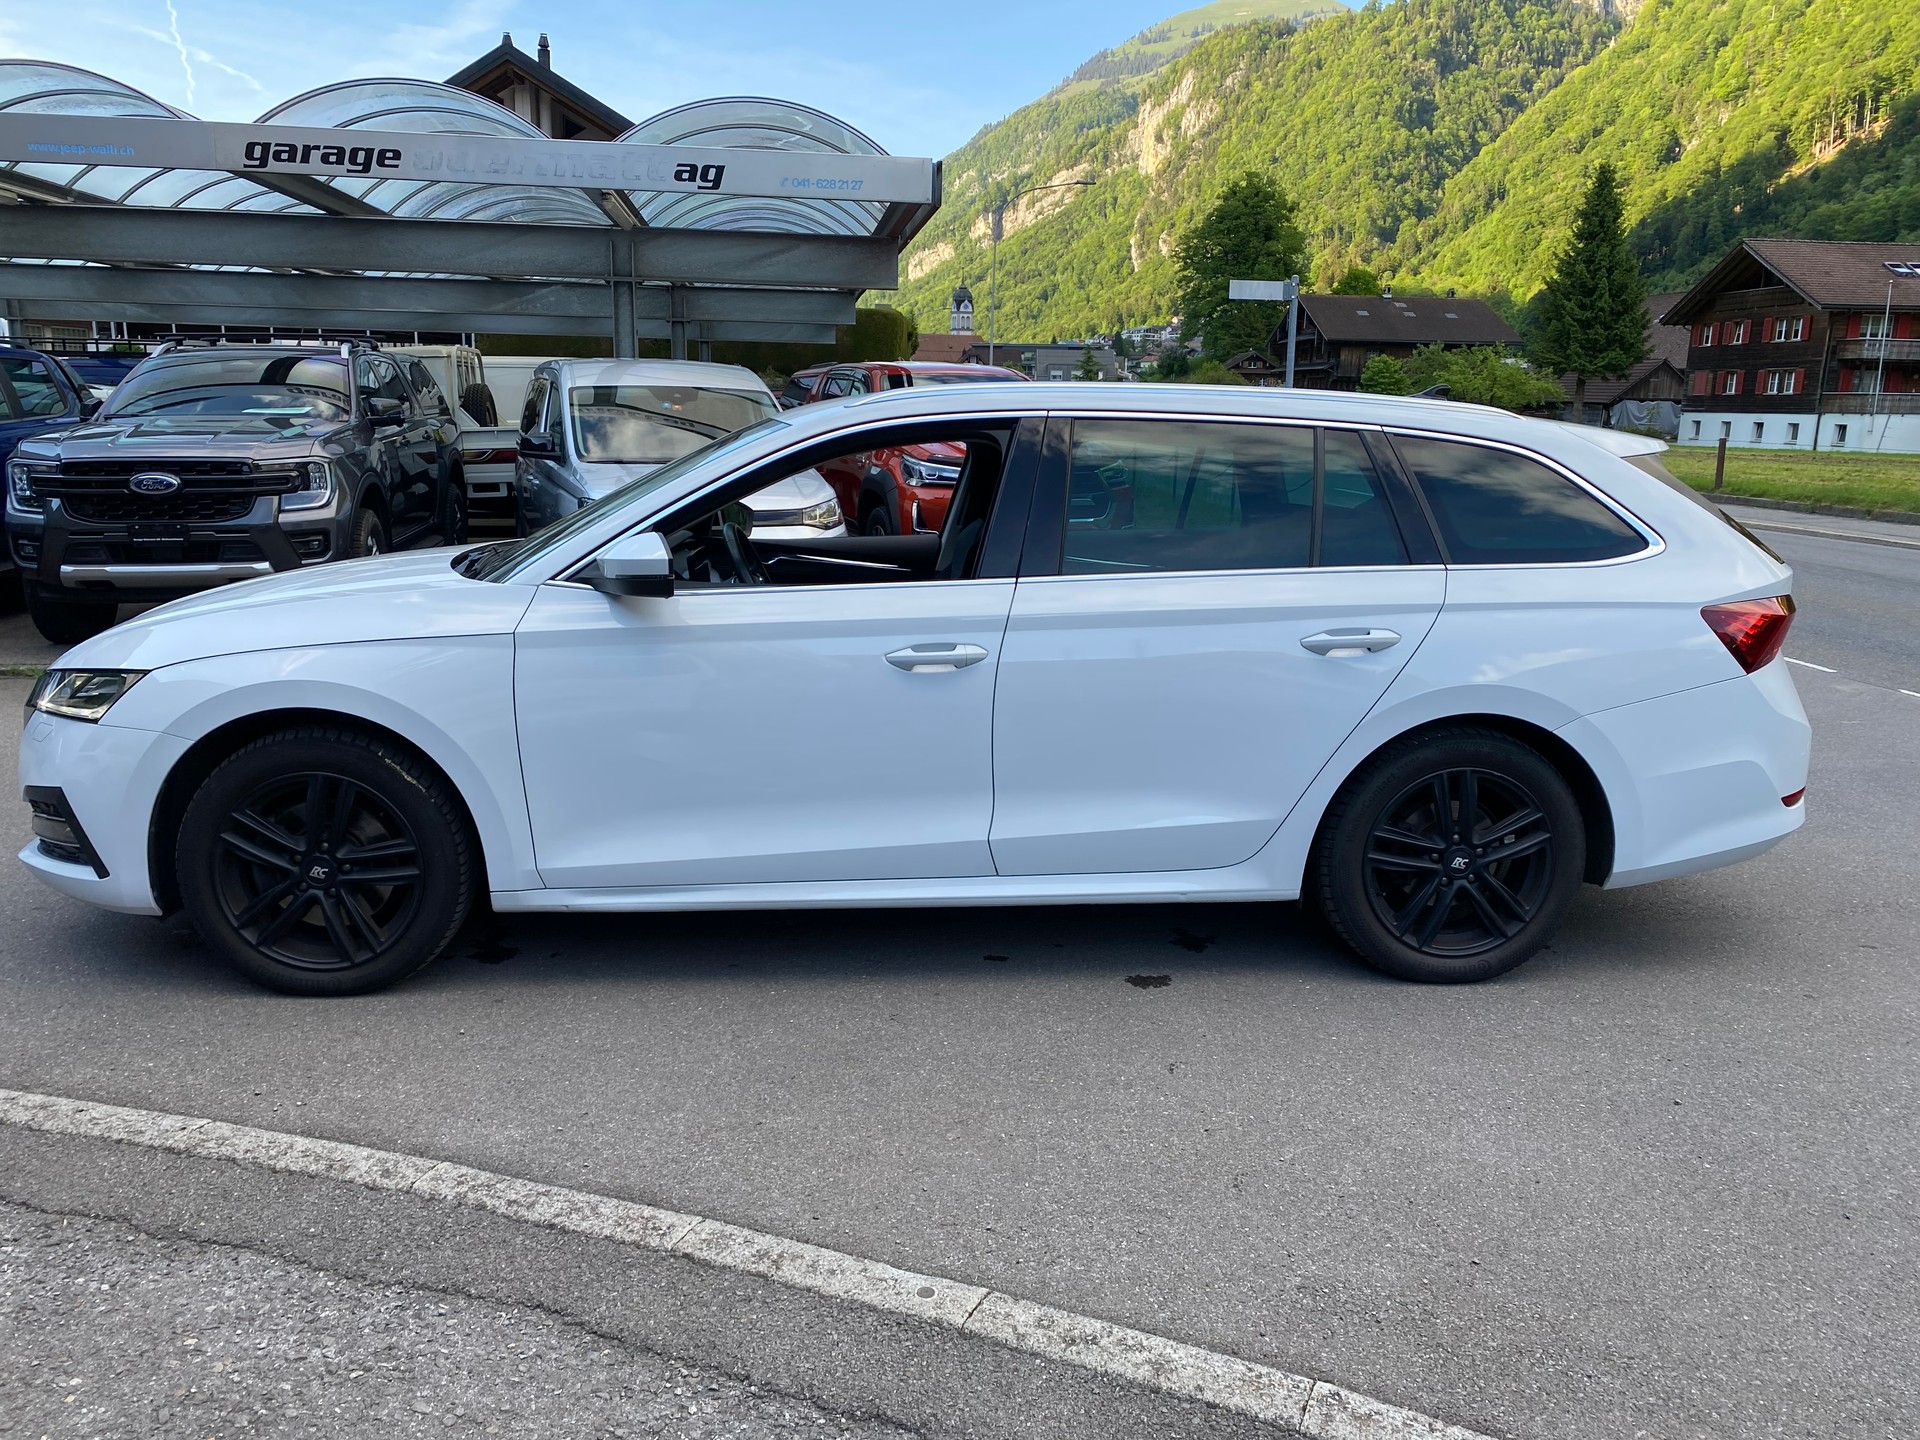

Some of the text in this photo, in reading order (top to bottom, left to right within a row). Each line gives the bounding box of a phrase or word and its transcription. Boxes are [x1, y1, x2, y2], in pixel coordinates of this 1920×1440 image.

[243, 141, 402, 174] garage
[673, 162, 726, 190] ag
[140, 479, 167, 490] Ford
[1450, 856, 1469, 870] RC
[309, 865, 329, 880] RC
